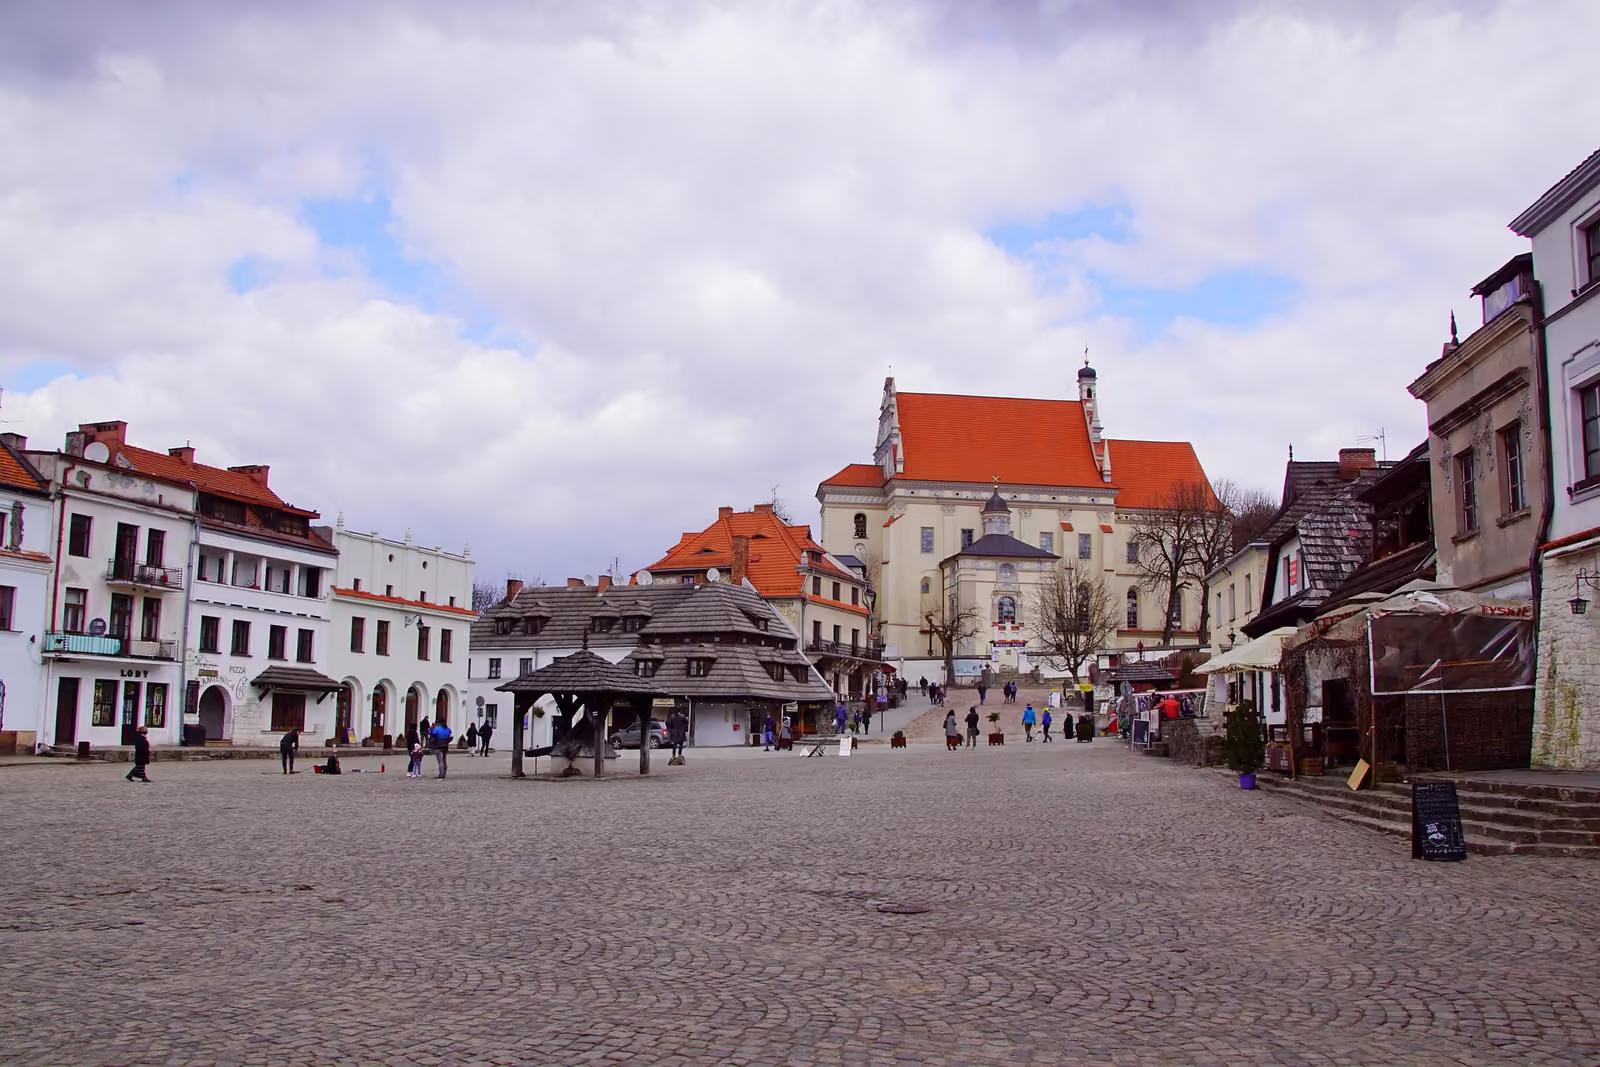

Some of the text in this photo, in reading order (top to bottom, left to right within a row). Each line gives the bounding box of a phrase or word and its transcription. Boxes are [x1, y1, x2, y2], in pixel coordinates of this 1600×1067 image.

[1479, 604, 1530, 617] TYSKIE
[120, 669, 149, 678] LODY
[229, 665, 247, 674] PIZZA
